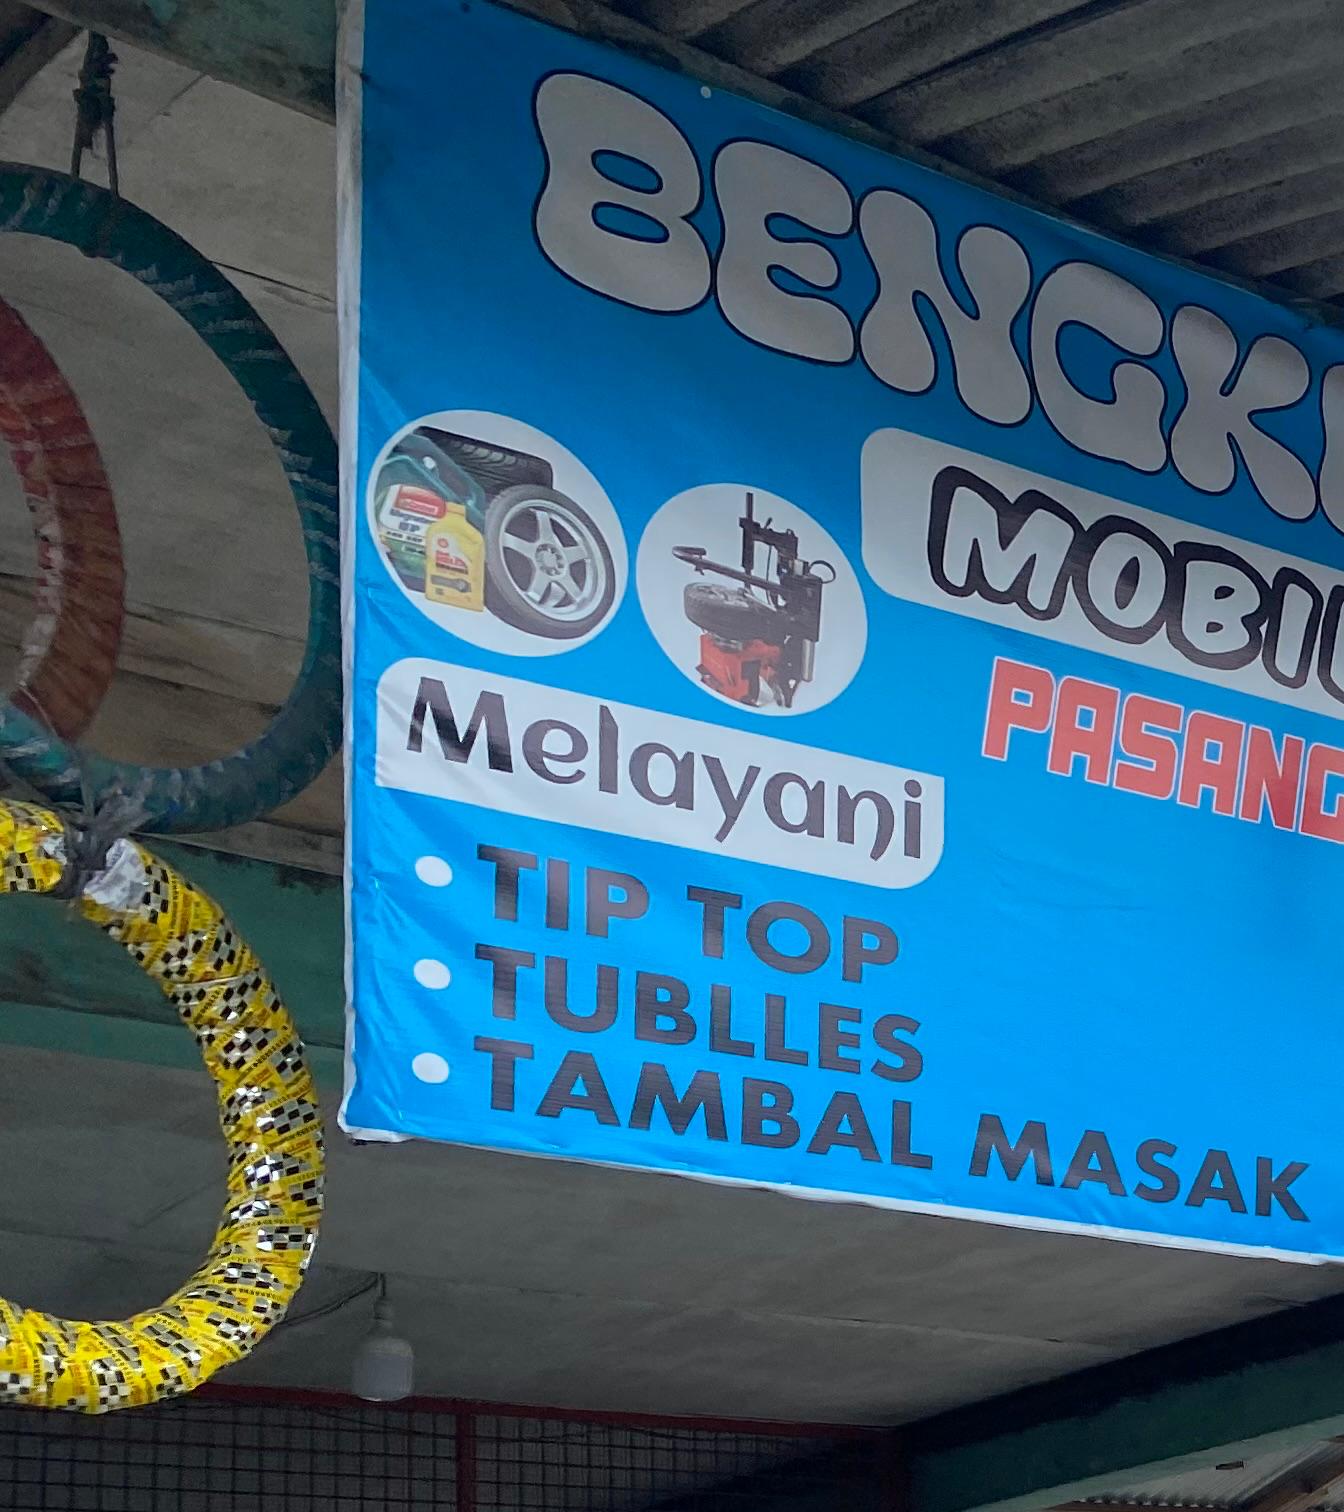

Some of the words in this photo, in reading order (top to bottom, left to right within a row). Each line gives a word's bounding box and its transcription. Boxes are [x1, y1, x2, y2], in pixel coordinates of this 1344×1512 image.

[406, 676, 925, 861] Melayani
[477, 843, 649, 937] TIP
[686, 884, 899, 984] TOP
[474, 943, 924, 1083] TUBLLES
[474, 1035, 935, 1171] TAMBAL
[968, 1114, 1311, 1224] MASAK
